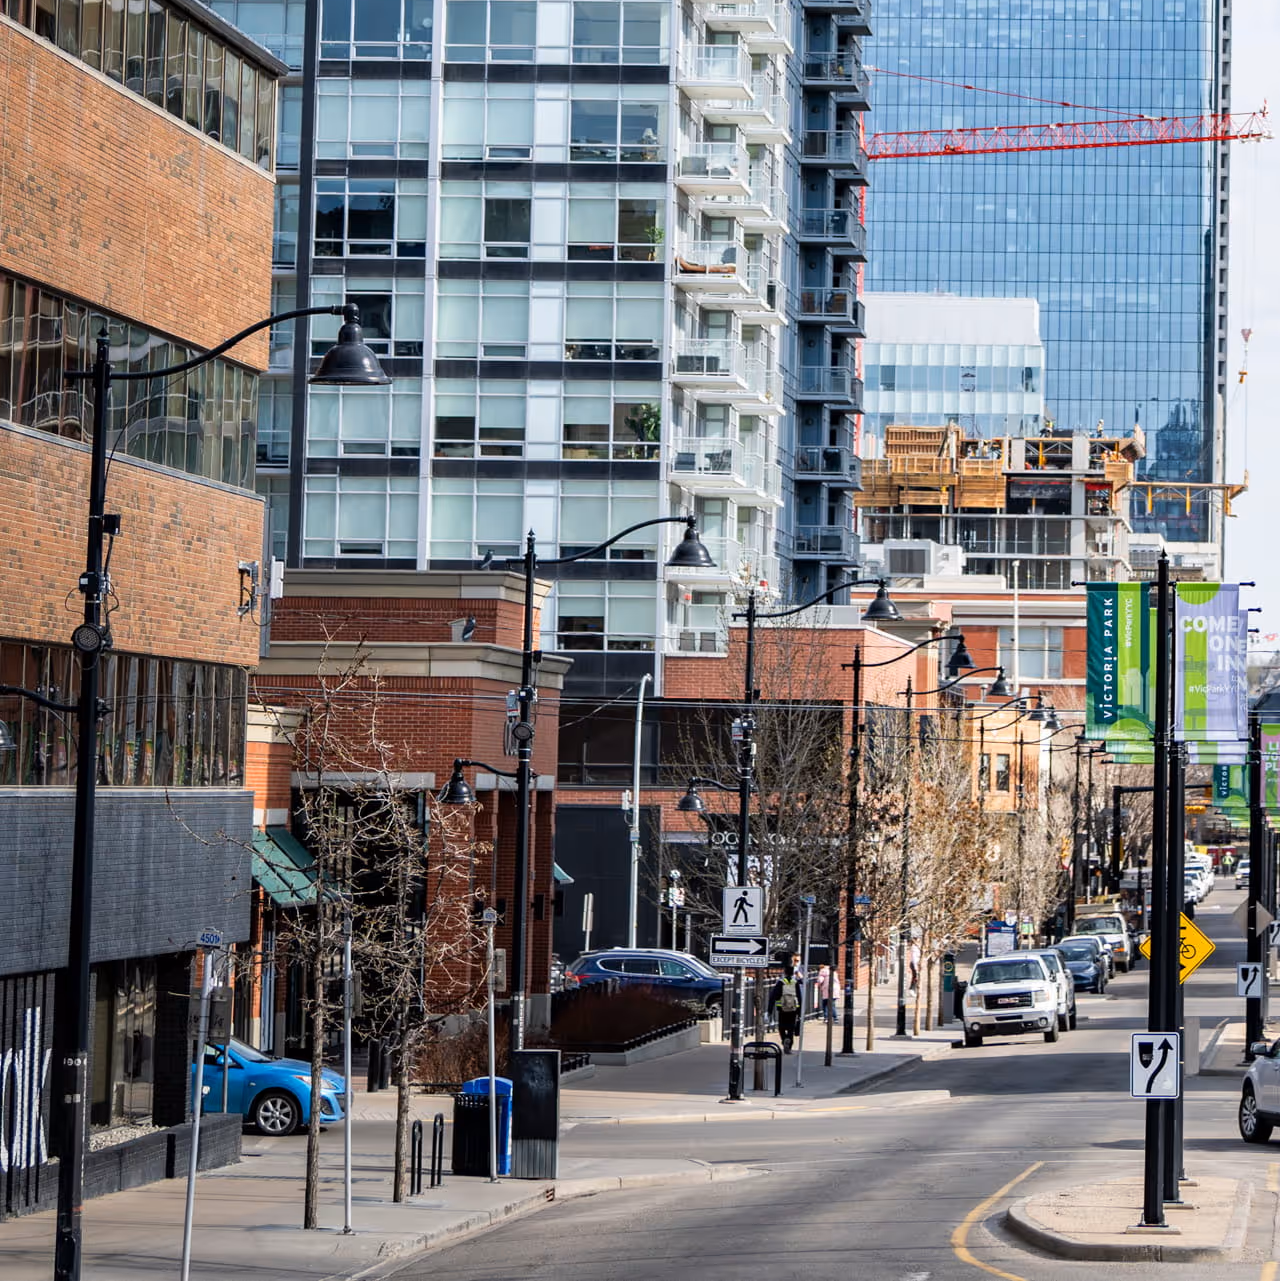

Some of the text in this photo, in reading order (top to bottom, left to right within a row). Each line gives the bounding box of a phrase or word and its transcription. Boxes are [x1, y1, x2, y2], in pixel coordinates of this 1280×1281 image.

[1103, 598, 1113, 637] PARK
[1179, 615, 1239, 633] COME
[200, 932, 218, 944] 4501
